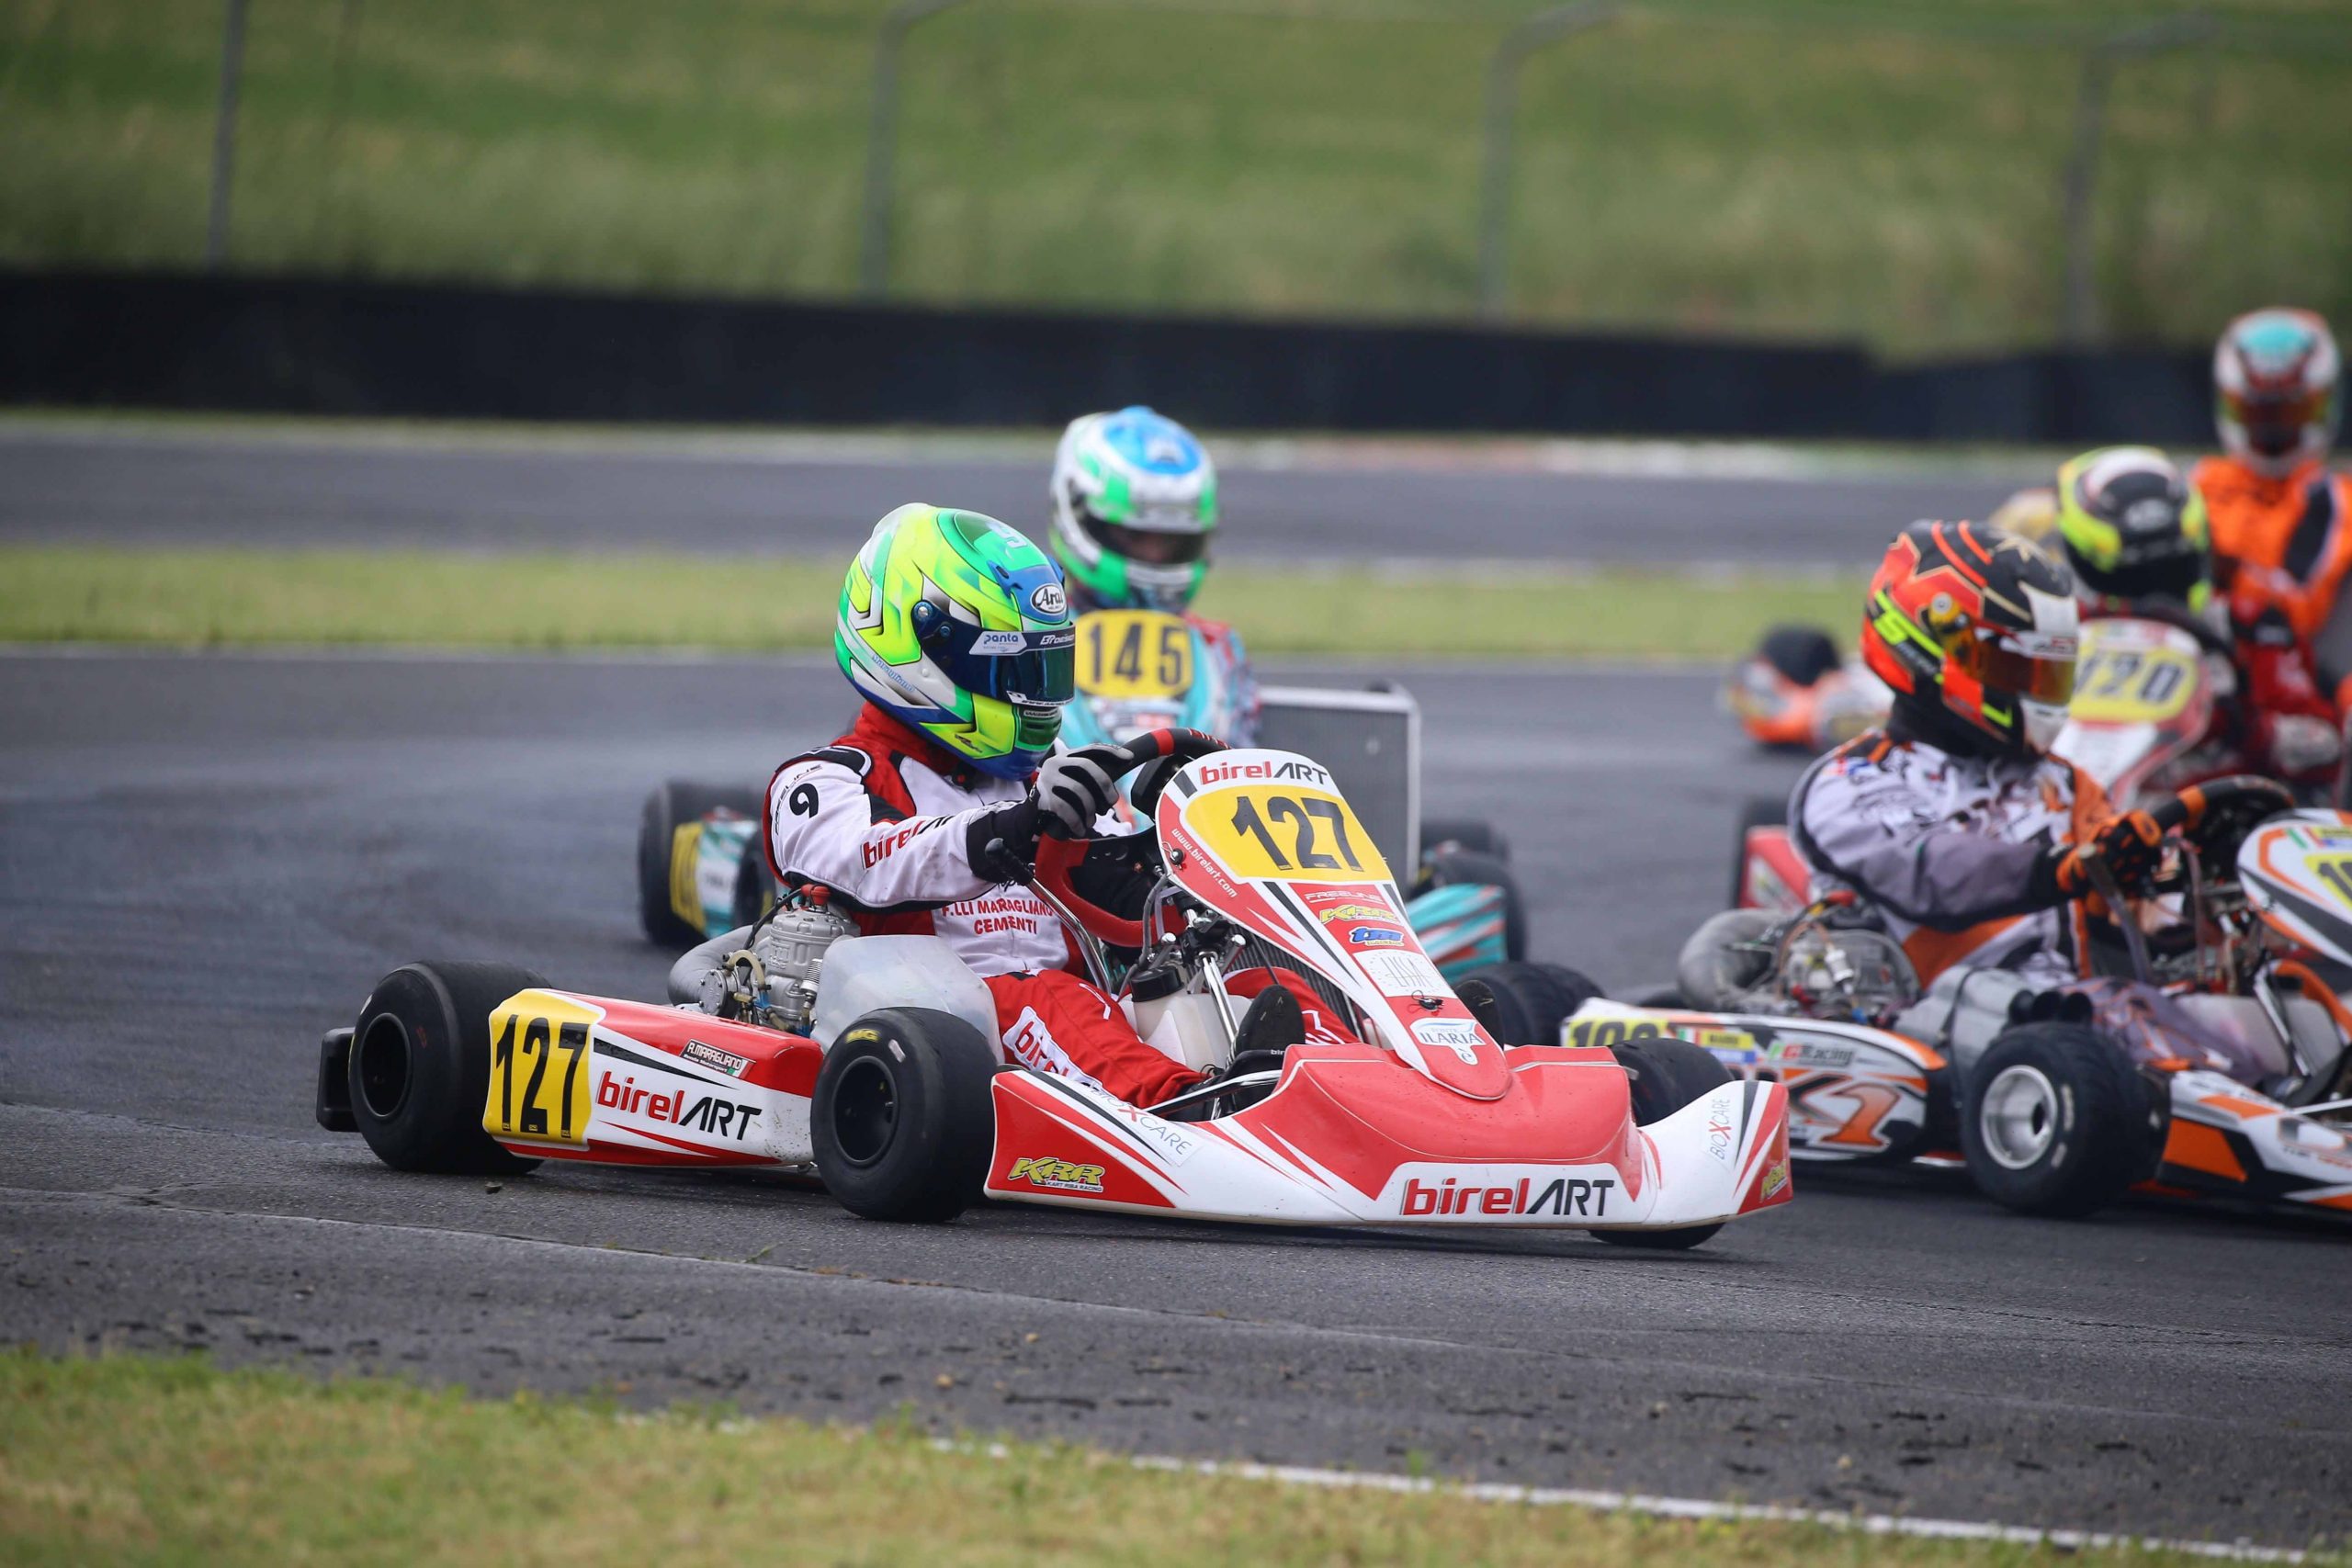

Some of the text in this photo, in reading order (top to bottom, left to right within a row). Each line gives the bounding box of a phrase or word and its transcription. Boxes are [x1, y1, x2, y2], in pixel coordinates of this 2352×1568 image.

[983, 633, 1020, 645] panta
[1089, 622, 1186, 685] 145
[1199, 761, 1329, 786] birelART
[789, 783, 820, 818] 9
[1231, 795, 1365, 873] 127
[1171, 828, 1238, 897] www.birelart.com
[2317, 862, 2352, 902] 1
[974, 915, 1037, 935] CEMENTI
[978, 897, 1055, 917] MARAGLIANO
[1419, 1032, 1483, 1044] ILARIA
[496, 1014, 591, 1138] 127
[596, 1069, 763, 1141] birelART
[1708, 1099, 1733, 1160] BIOXCARE
[1009, 1156, 1104, 1185] KRR
[1080, 1184, 1102, 1192] RACING
[1401, 1178, 1615, 1216] birelART
